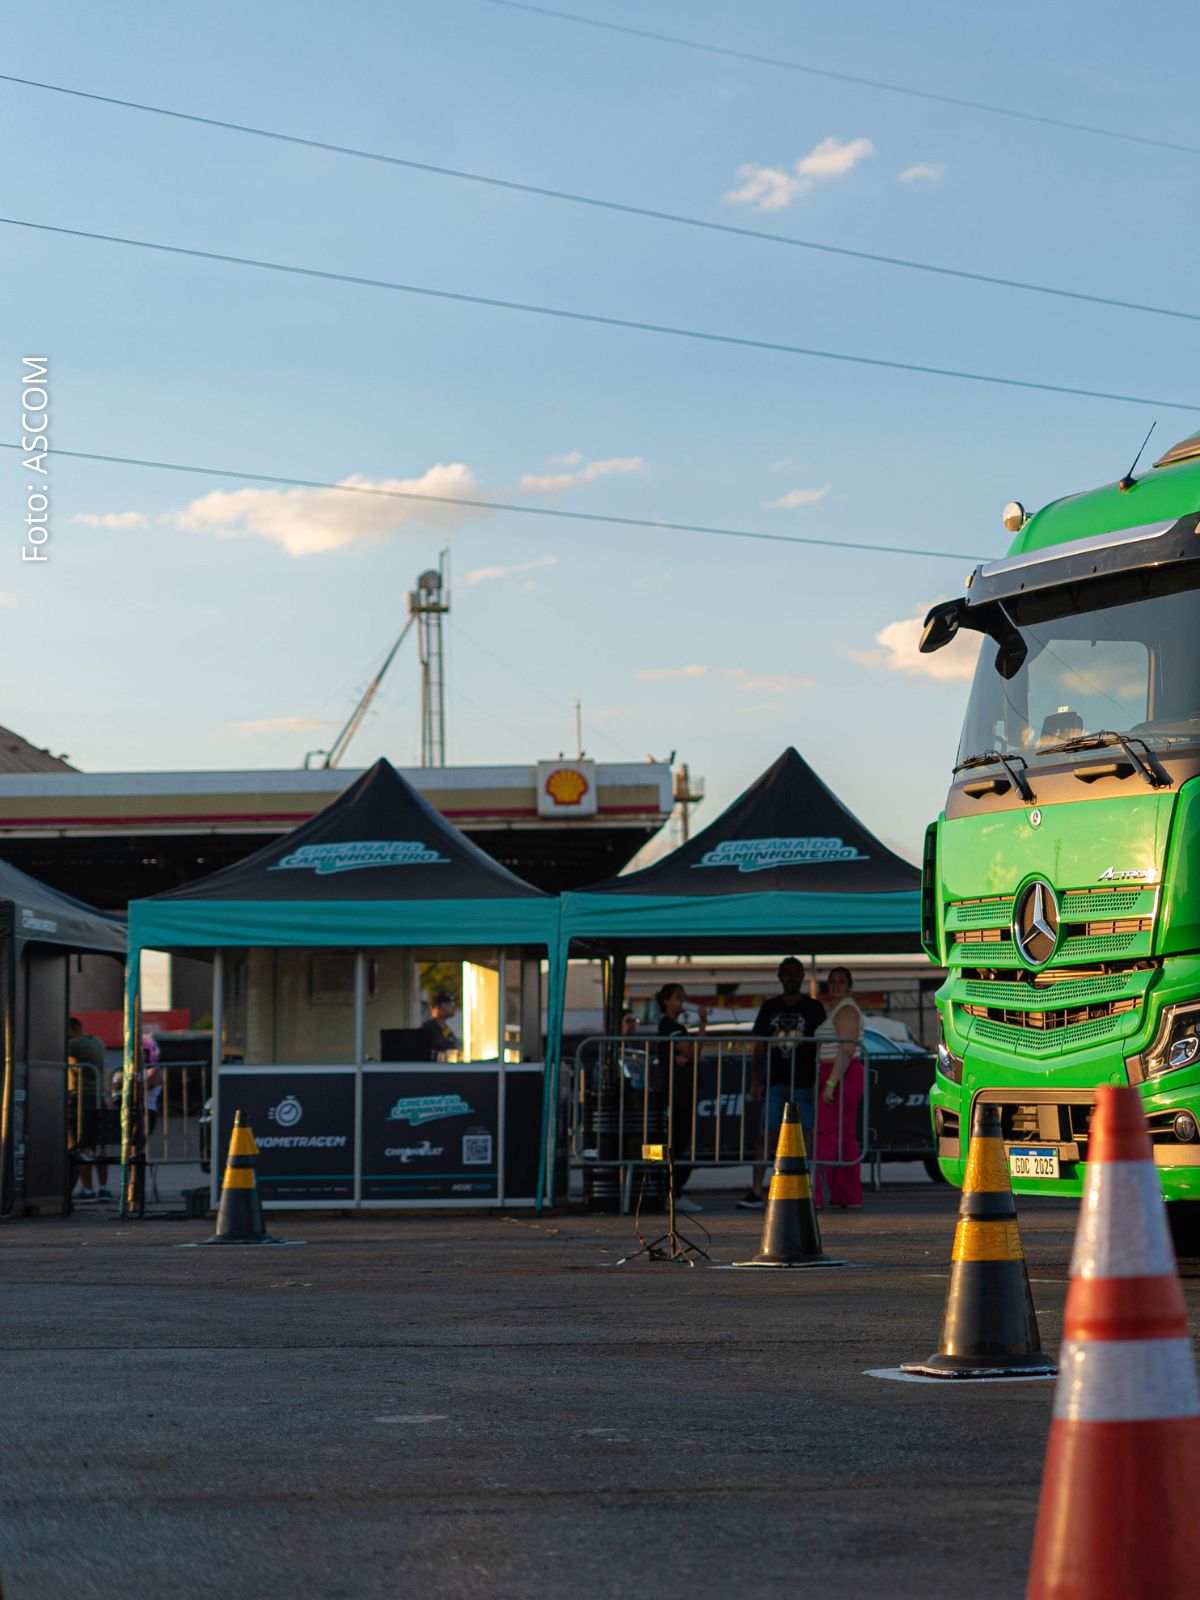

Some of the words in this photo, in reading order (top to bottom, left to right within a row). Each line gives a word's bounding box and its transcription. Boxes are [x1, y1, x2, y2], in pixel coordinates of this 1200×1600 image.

[286, 852, 434, 865] CAMINHONEIRO
[707, 848, 853, 863] CAMINHONEIRO
[1015, 1157, 1030, 1174] GDC
[1034, 1158, 1054, 1175] 2025
